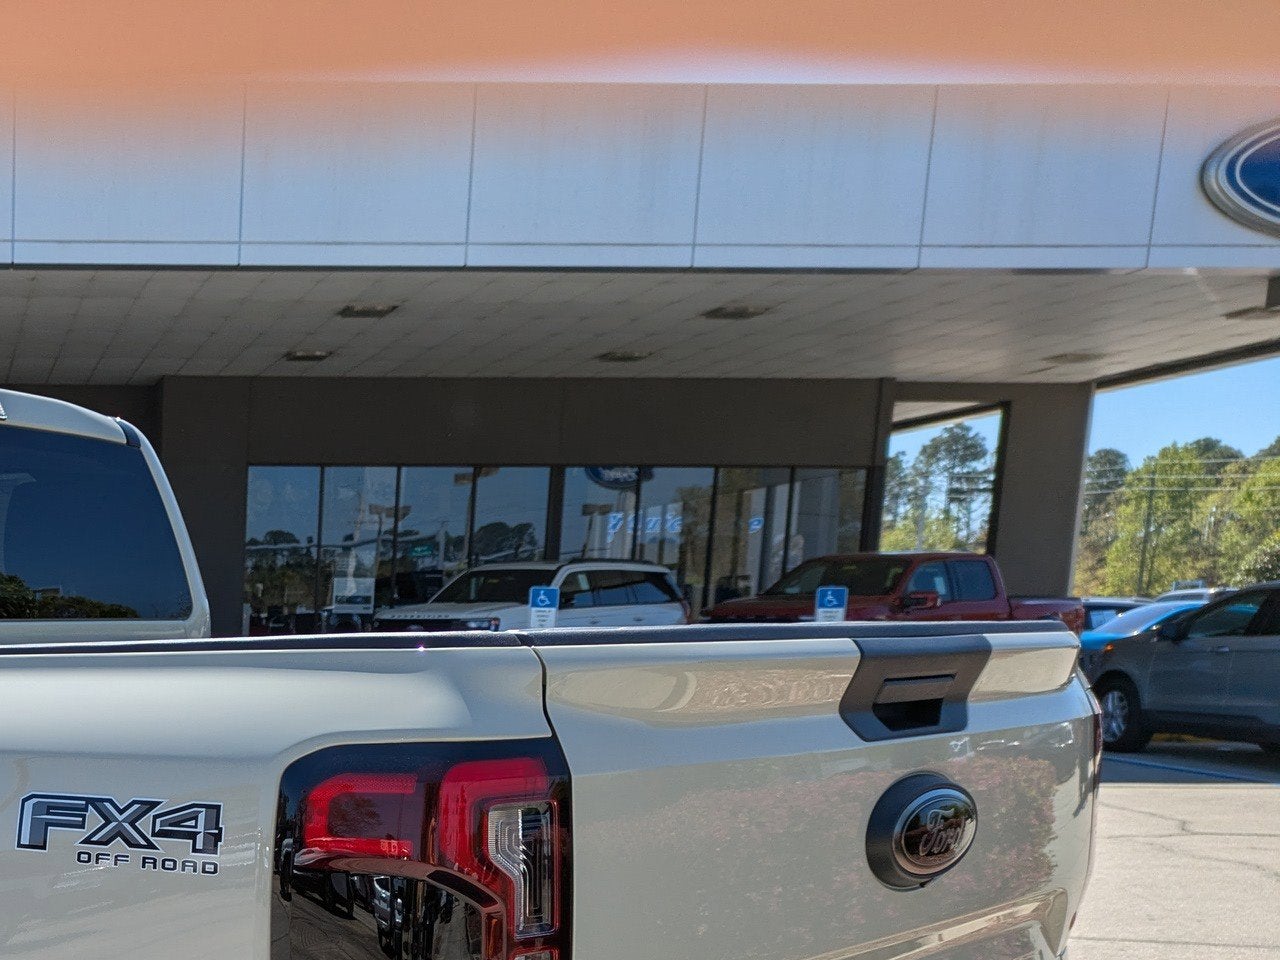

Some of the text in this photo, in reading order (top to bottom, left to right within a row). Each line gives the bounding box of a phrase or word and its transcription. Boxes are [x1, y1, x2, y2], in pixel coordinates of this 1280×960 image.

[15, 791, 225, 857] FX4
[76, 850, 220, 875] OFF ROAD
